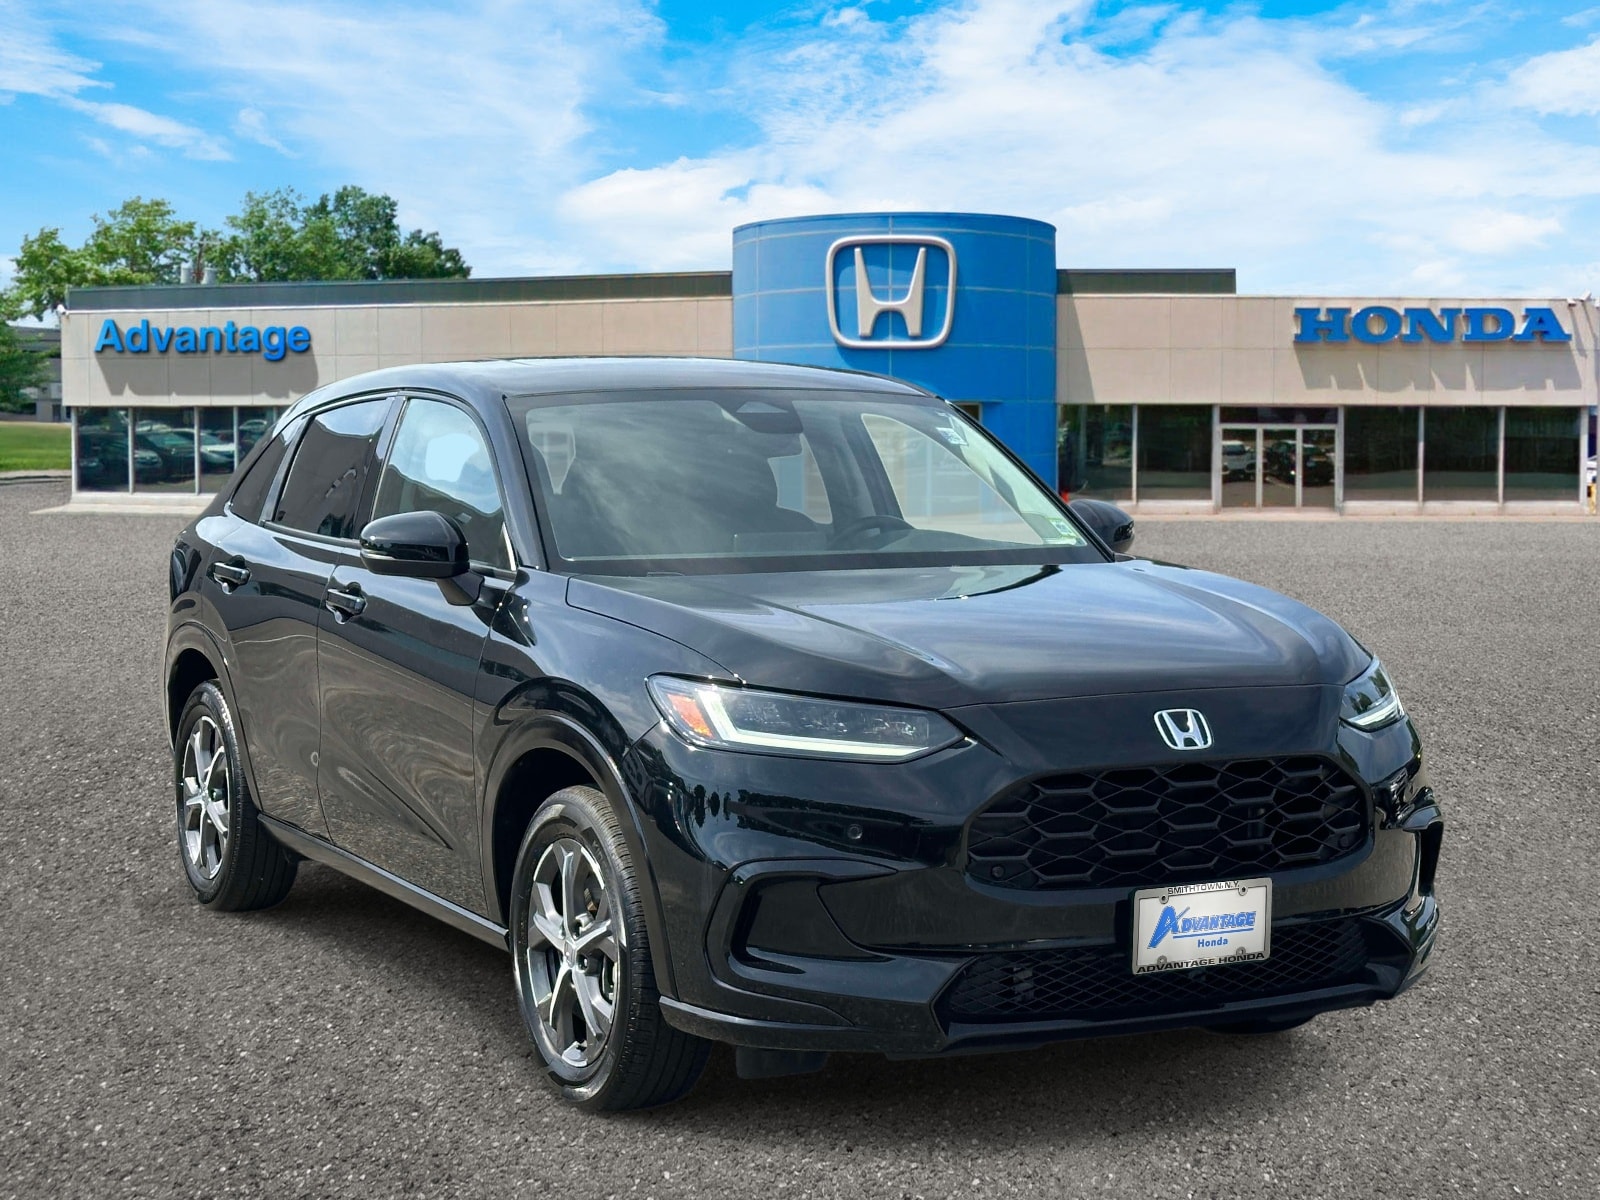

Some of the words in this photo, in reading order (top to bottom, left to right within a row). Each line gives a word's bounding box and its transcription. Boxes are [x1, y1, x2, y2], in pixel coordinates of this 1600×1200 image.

[1294, 306, 1573, 343] HONDA
[94, 318, 312, 362] Advantage
[1197, 937, 1229, 949] Honda
[1136, 957, 1216, 974] ADVANTAGE
[1218, 951, 1265, 964] HONDA
